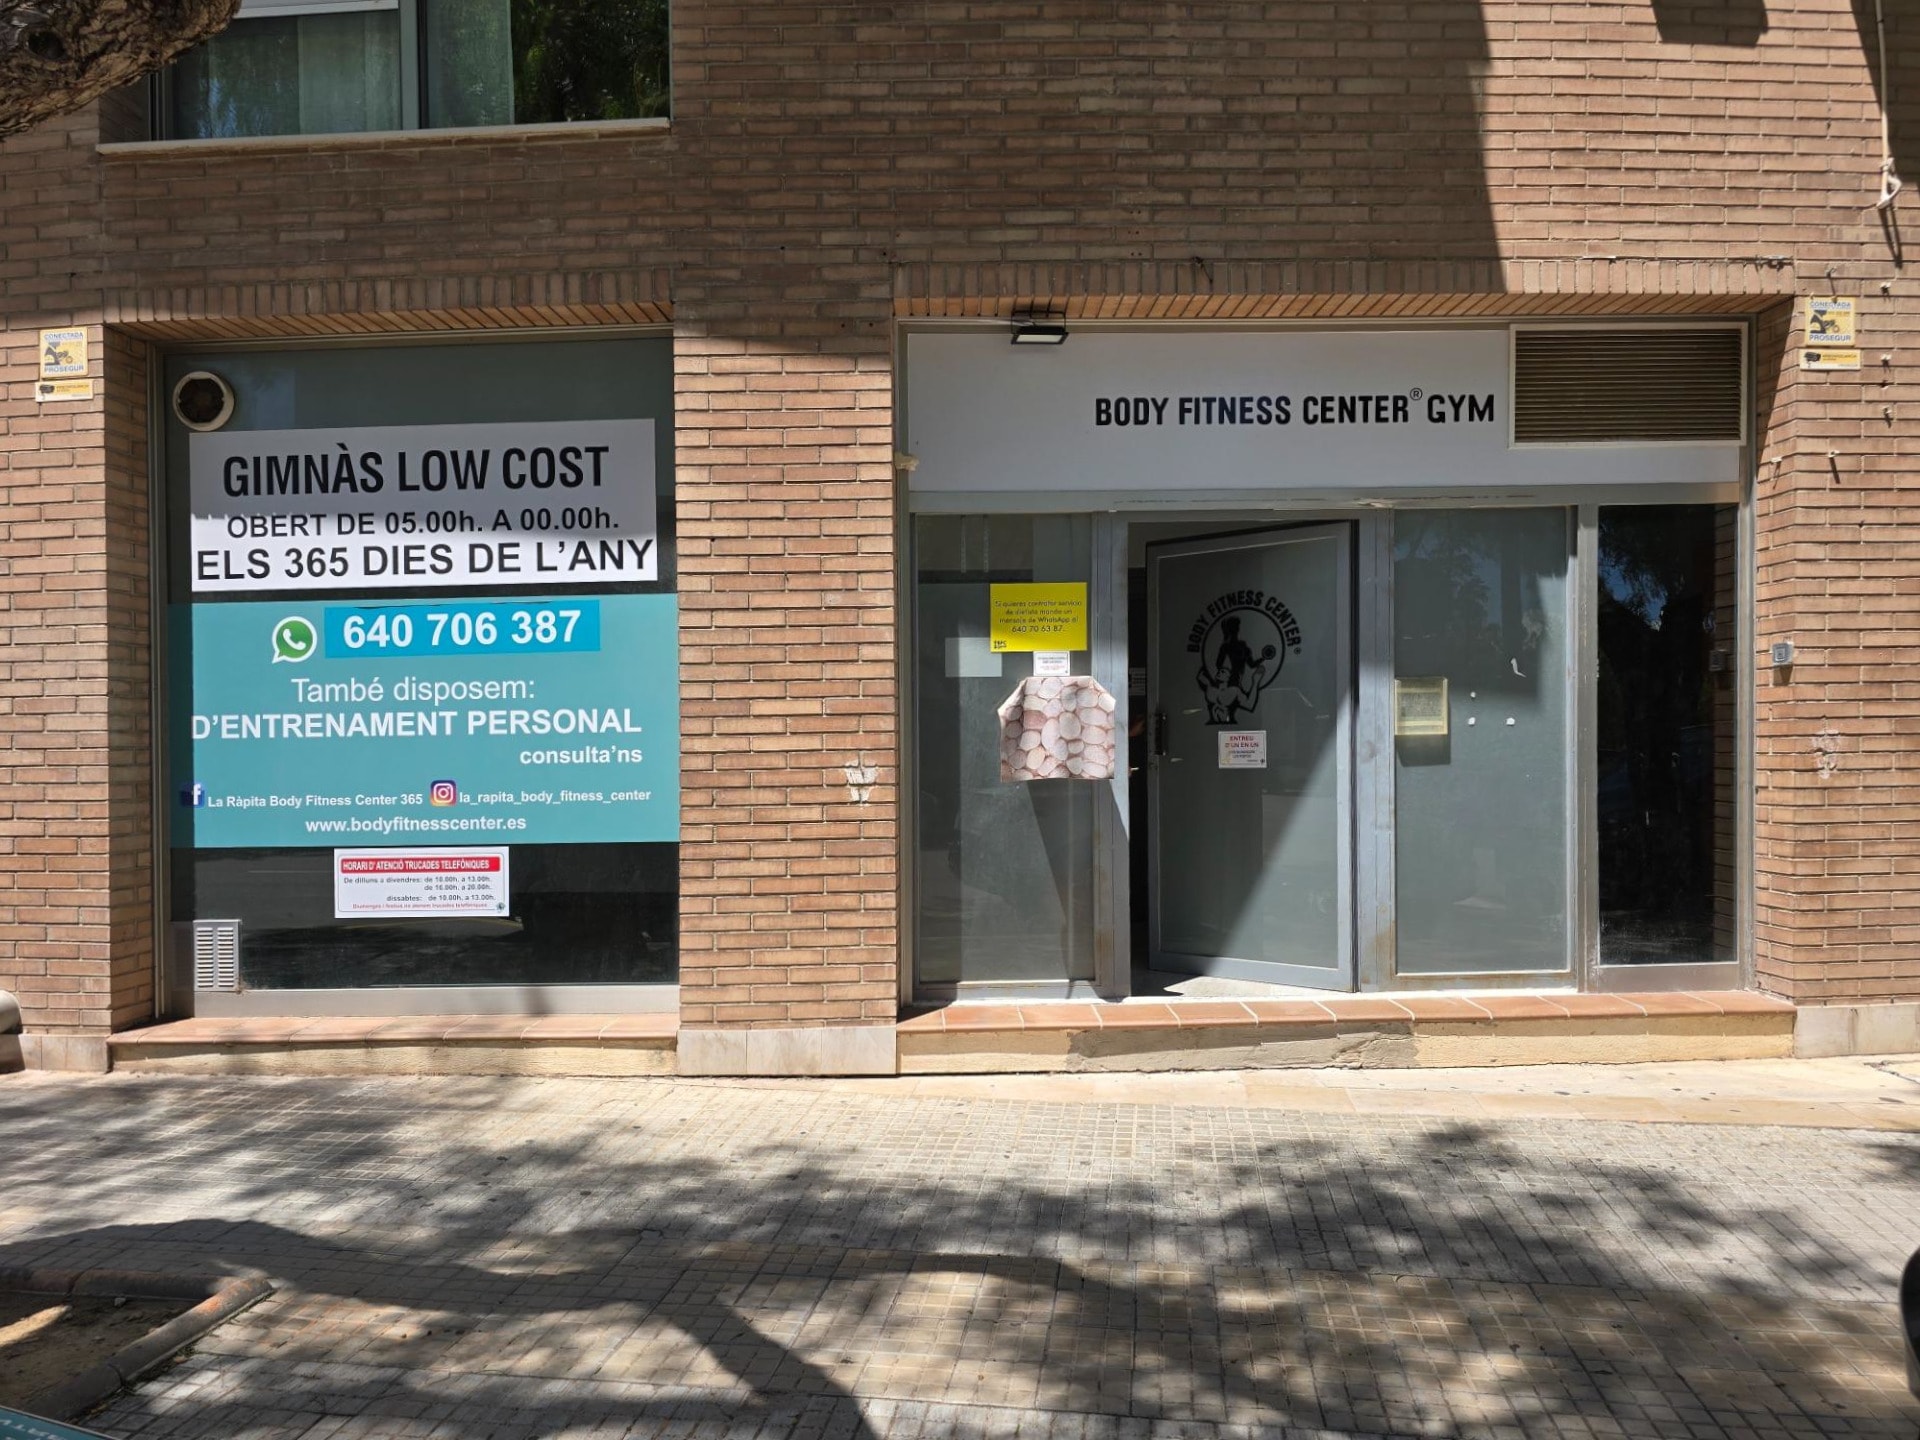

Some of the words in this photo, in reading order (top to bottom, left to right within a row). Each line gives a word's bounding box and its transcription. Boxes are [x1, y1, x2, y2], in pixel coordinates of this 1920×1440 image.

[44, 365, 84, 373] PROSEGUR
[1095, 397, 1169, 426] BODY
[1178, 396, 1291, 425] FITNESS
[1427, 394, 1495, 423] GYM
[223, 442, 385, 497] GIMNÀS
[398, 449, 491, 493] LOW
[502, 446, 609, 490] COST
[227, 514, 327, 538] OBERT
[337, 512, 375, 535] DE
[385, 509, 483, 534] 05.00h.
[491, 509, 513, 531] A
[520, 506, 619, 531] 00.00h.
[197, 548, 271, 581] ELS
[284, 546, 349, 578] 365
[363, 543, 454, 576] DIES
[468, 541, 521, 574] DE
[343, 614, 414, 649] 640
[427, 611, 497, 647] 706
[511, 609, 582, 644] 387
[1038, 616, 1070, 624] WhatsApp
[1187, 614, 1209, 653] BODY
[1206, 589, 1264, 618] FITNESS
[290, 676, 384, 703] També
[393, 677, 535, 706] disposem:
[192, 710, 457, 740] D’ENTRENAMENT
[467, 708, 642, 736] PERSONAL
[207, 796, 223, 808] La
[226, 795, 267, 809] Ràpita
[269, 795, 302, 809] Body
[306, 794, 351, 806] Fitness
[355, 794, 397, 806] Center
[400, 793, 423, 805] 365
[459, 790, 651, 805] la_rapita_body_fitness_center
[305, 815, 527, 834] www.bodyfitnesscenter.es
[343, 861, 368, 871] HORARI
[376, 859, 404, 870] ATENCIÓ
[405, 860, 439, 870] TRUCADES
[441, 859, 489, 869] TELEFÒNIQUES
